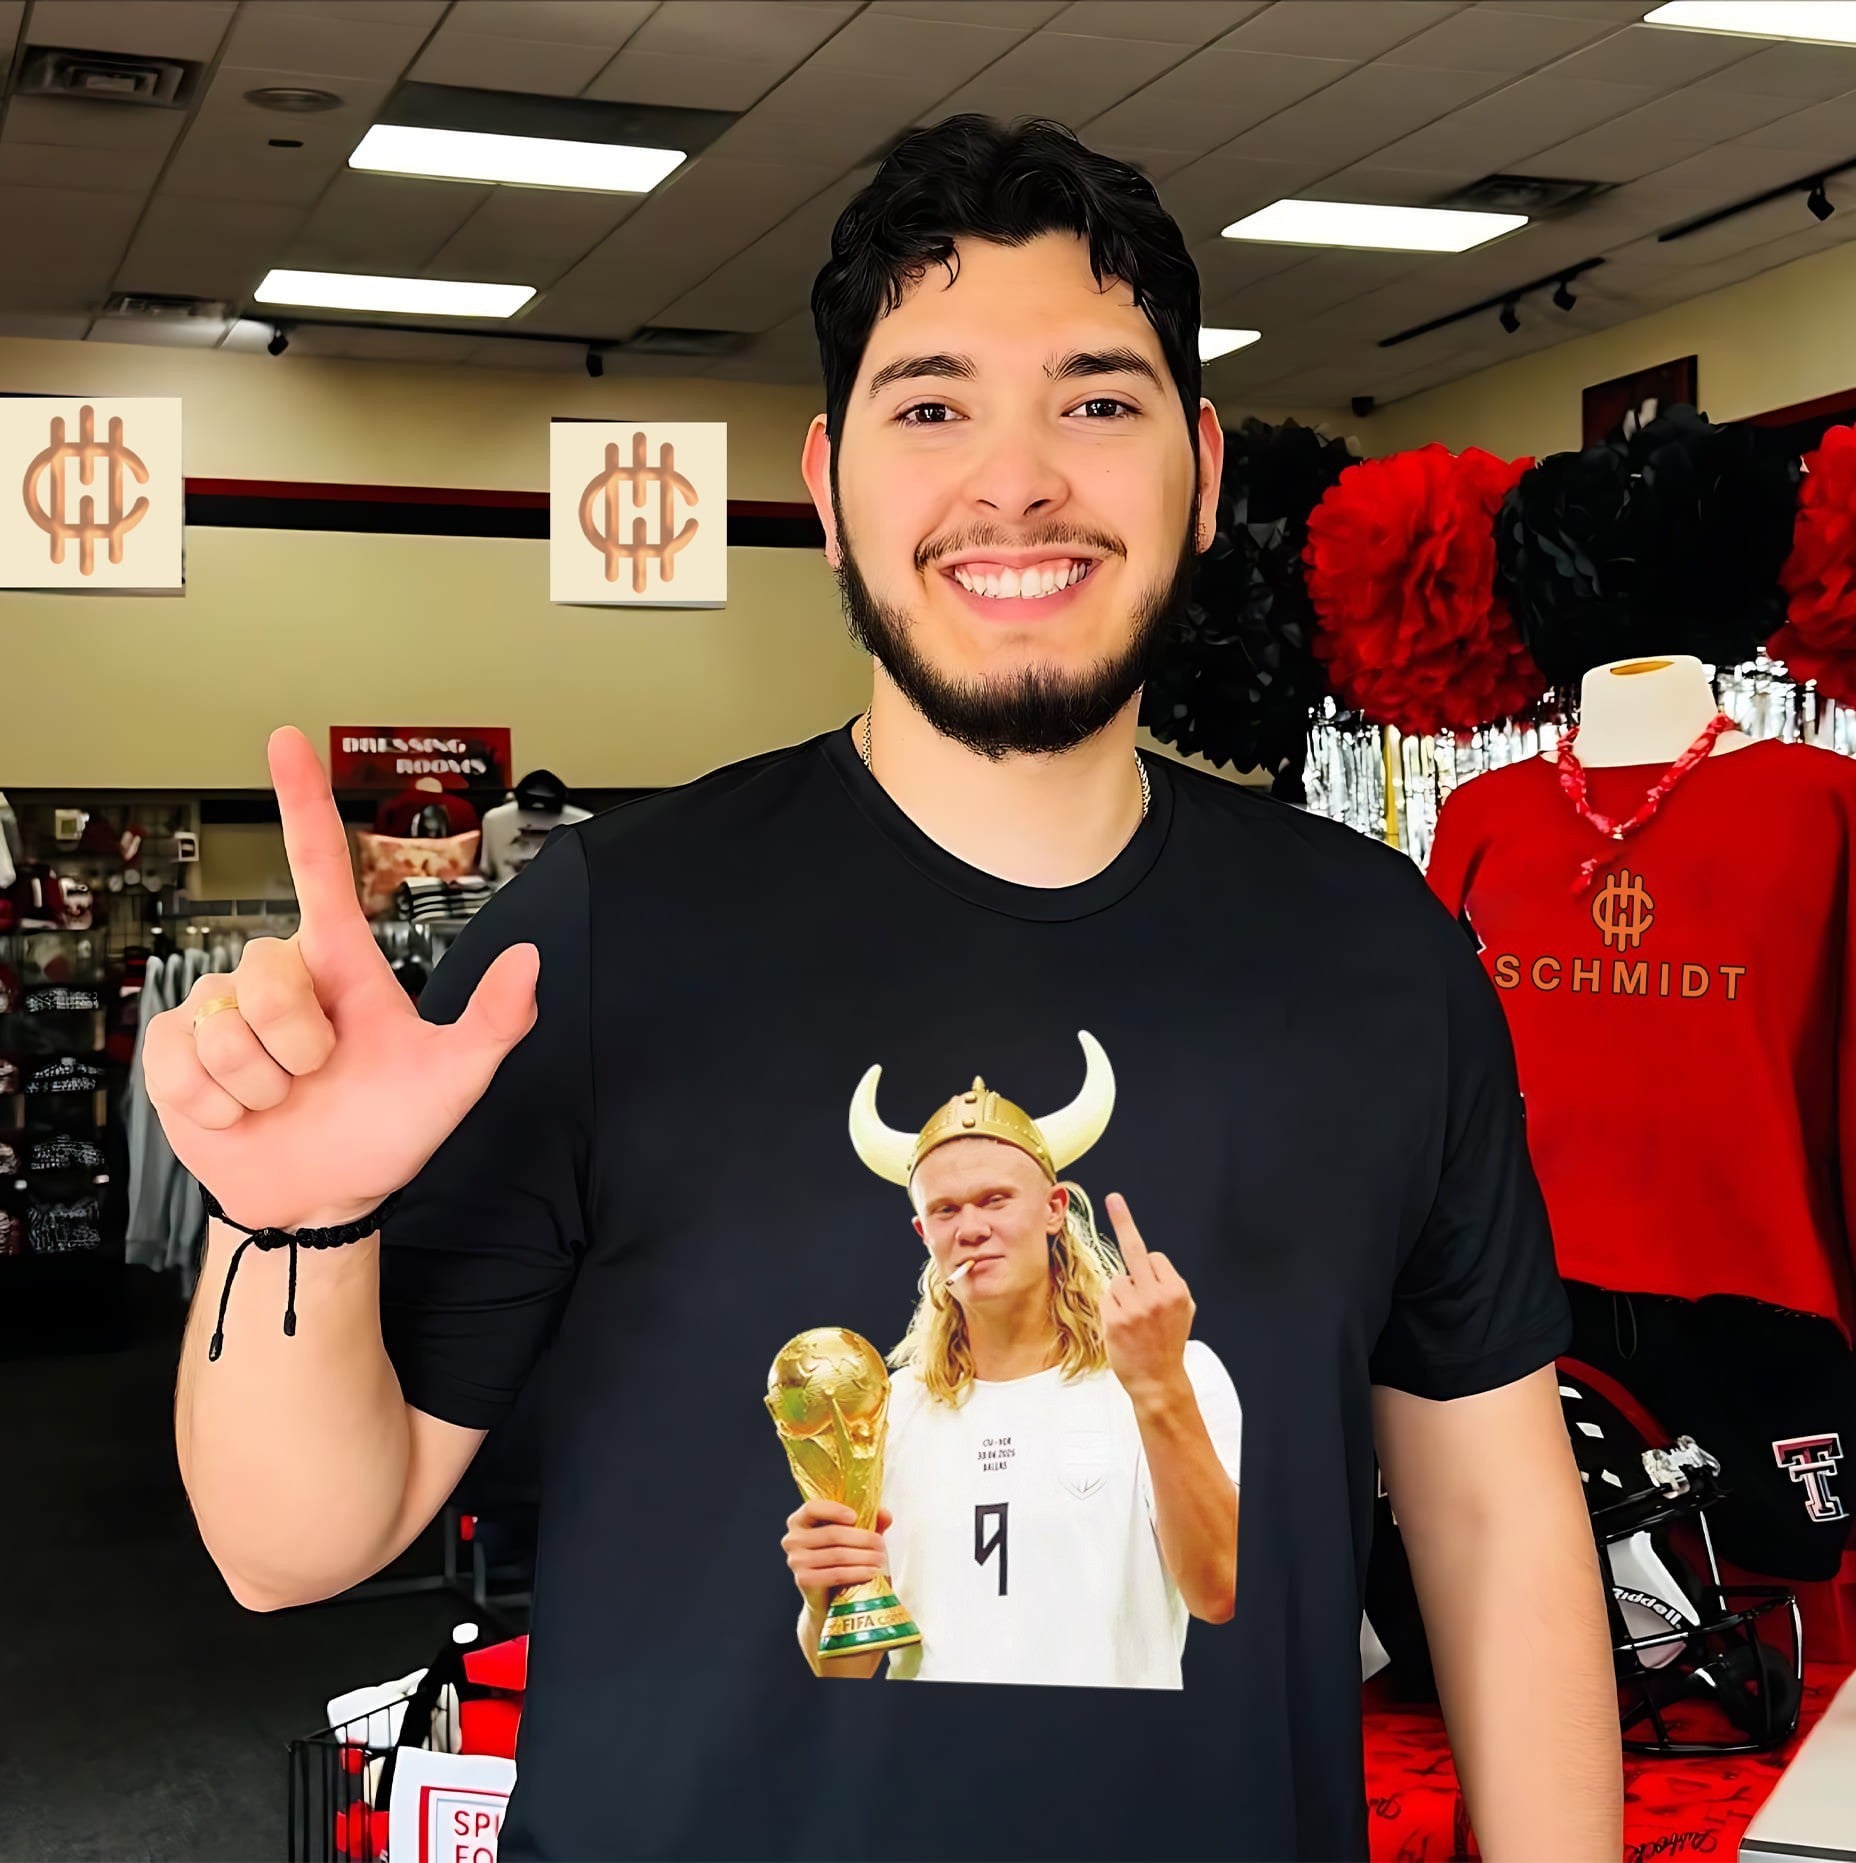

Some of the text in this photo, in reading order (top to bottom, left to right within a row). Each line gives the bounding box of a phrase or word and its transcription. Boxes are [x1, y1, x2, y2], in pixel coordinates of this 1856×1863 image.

[342, 738, 466, 754] DRESSING
[396, 759, 487, 774] ROOMS
[1494, 953, 1747, 1001] SCHMIDT
[974, 1501, 1009, 1597] 9
[1612, 1587, 1682, 1627] Riddell
[842, 1615, 875, 1632] FIFA
